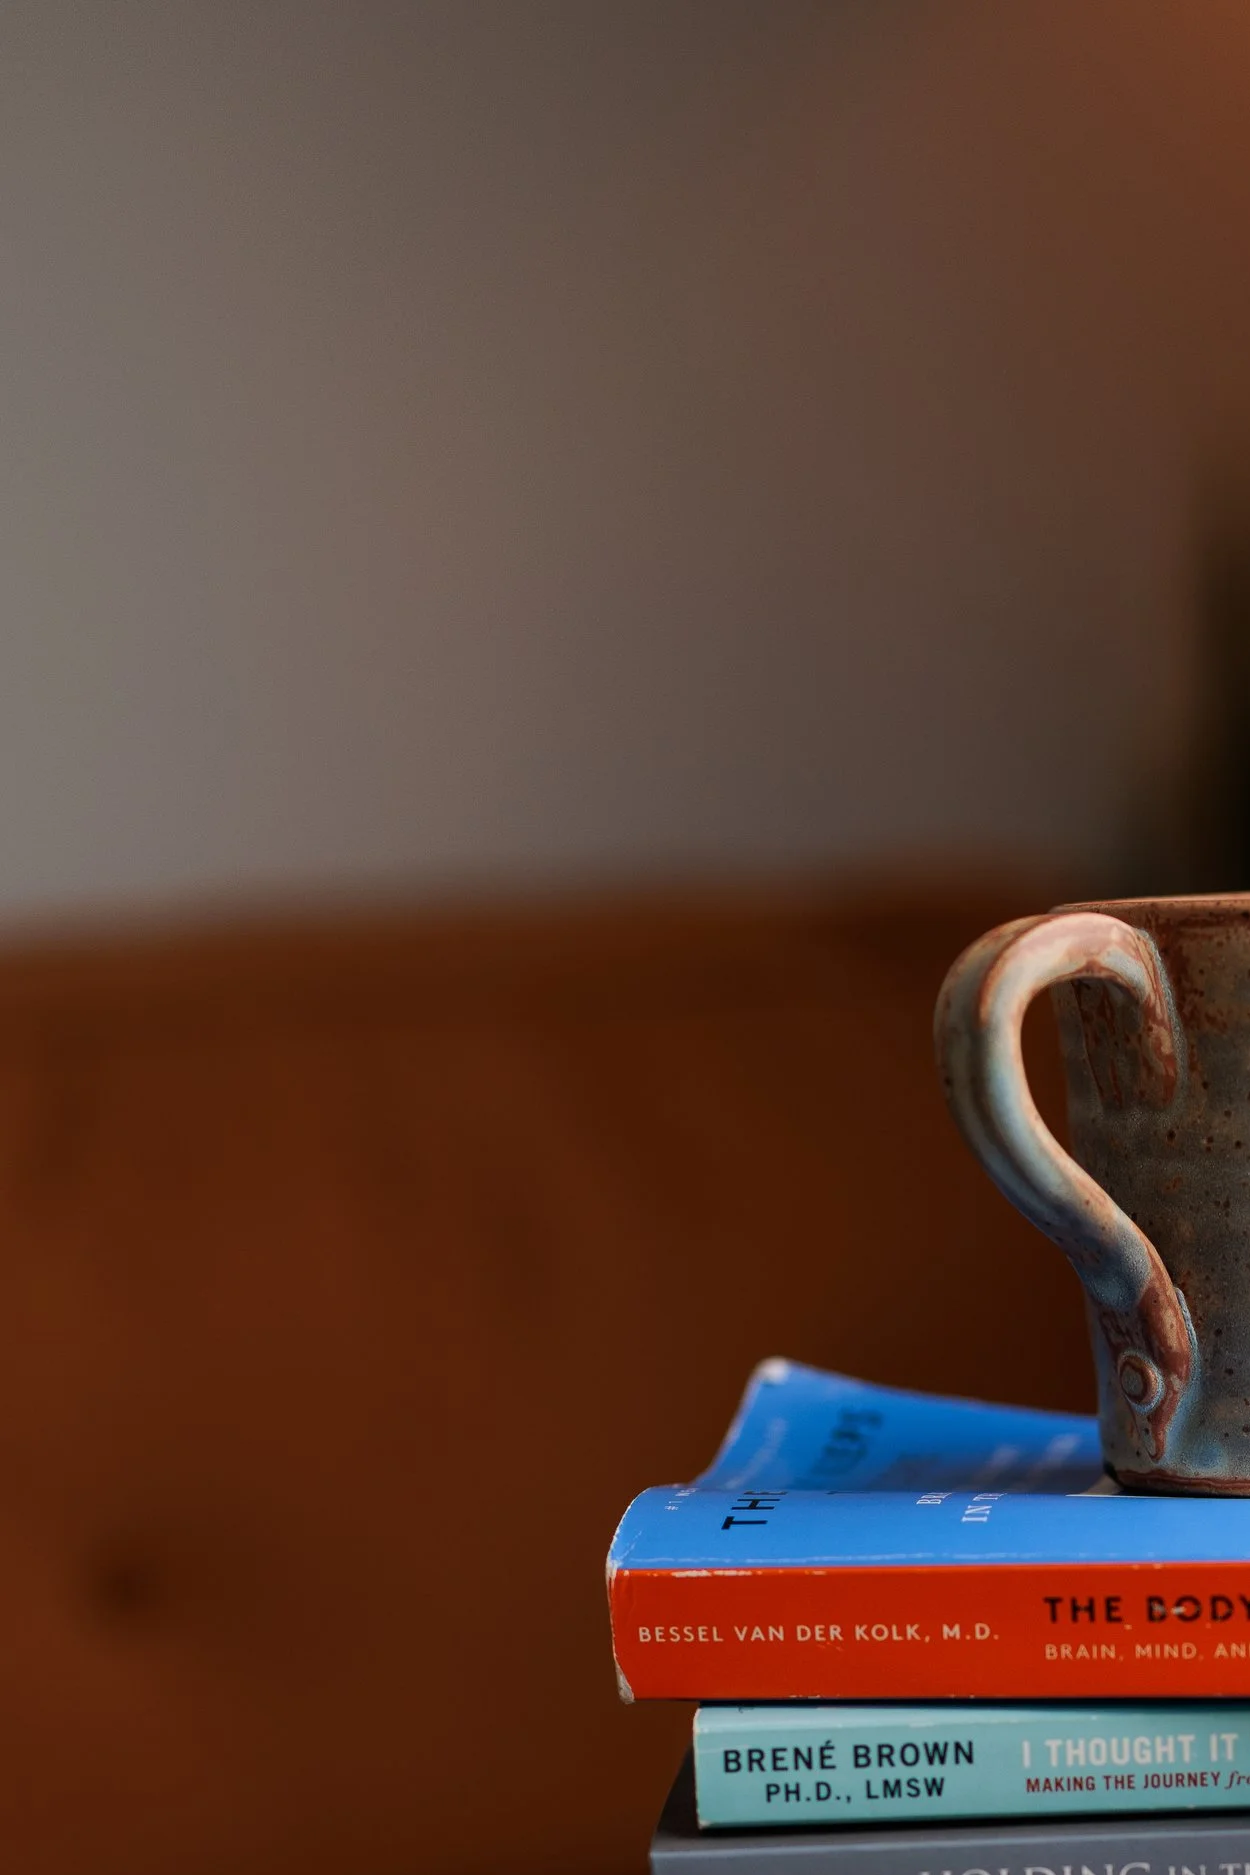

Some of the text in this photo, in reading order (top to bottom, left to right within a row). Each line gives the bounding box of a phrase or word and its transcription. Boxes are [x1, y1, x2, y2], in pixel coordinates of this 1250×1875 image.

[1043, 1595, 1124, 1624] THE
[638, 1622, 1000, 1643] BESSEL VAN DER KOLK, M.D.
[1044, 1643, 1124, 1662] BRAIN,
[1134, 1642, 1204, 1661] MIND,
[723, 1739, 975, 1773] BRENÉ BROWN
[1022, 1739, 1032, 1769] I
[1045, 1733, 1196, 1768] THOUGHT
[1210, 1732, 1239, 1763] IT
[765, 1777, 945, 1804] PH.D., LMSW
[1025, 1775, 1096, 1793] MAKING
[1104, 1774, 1136, 1790] THE
[1142, 1771, 1221, 1789] JOURNEY
